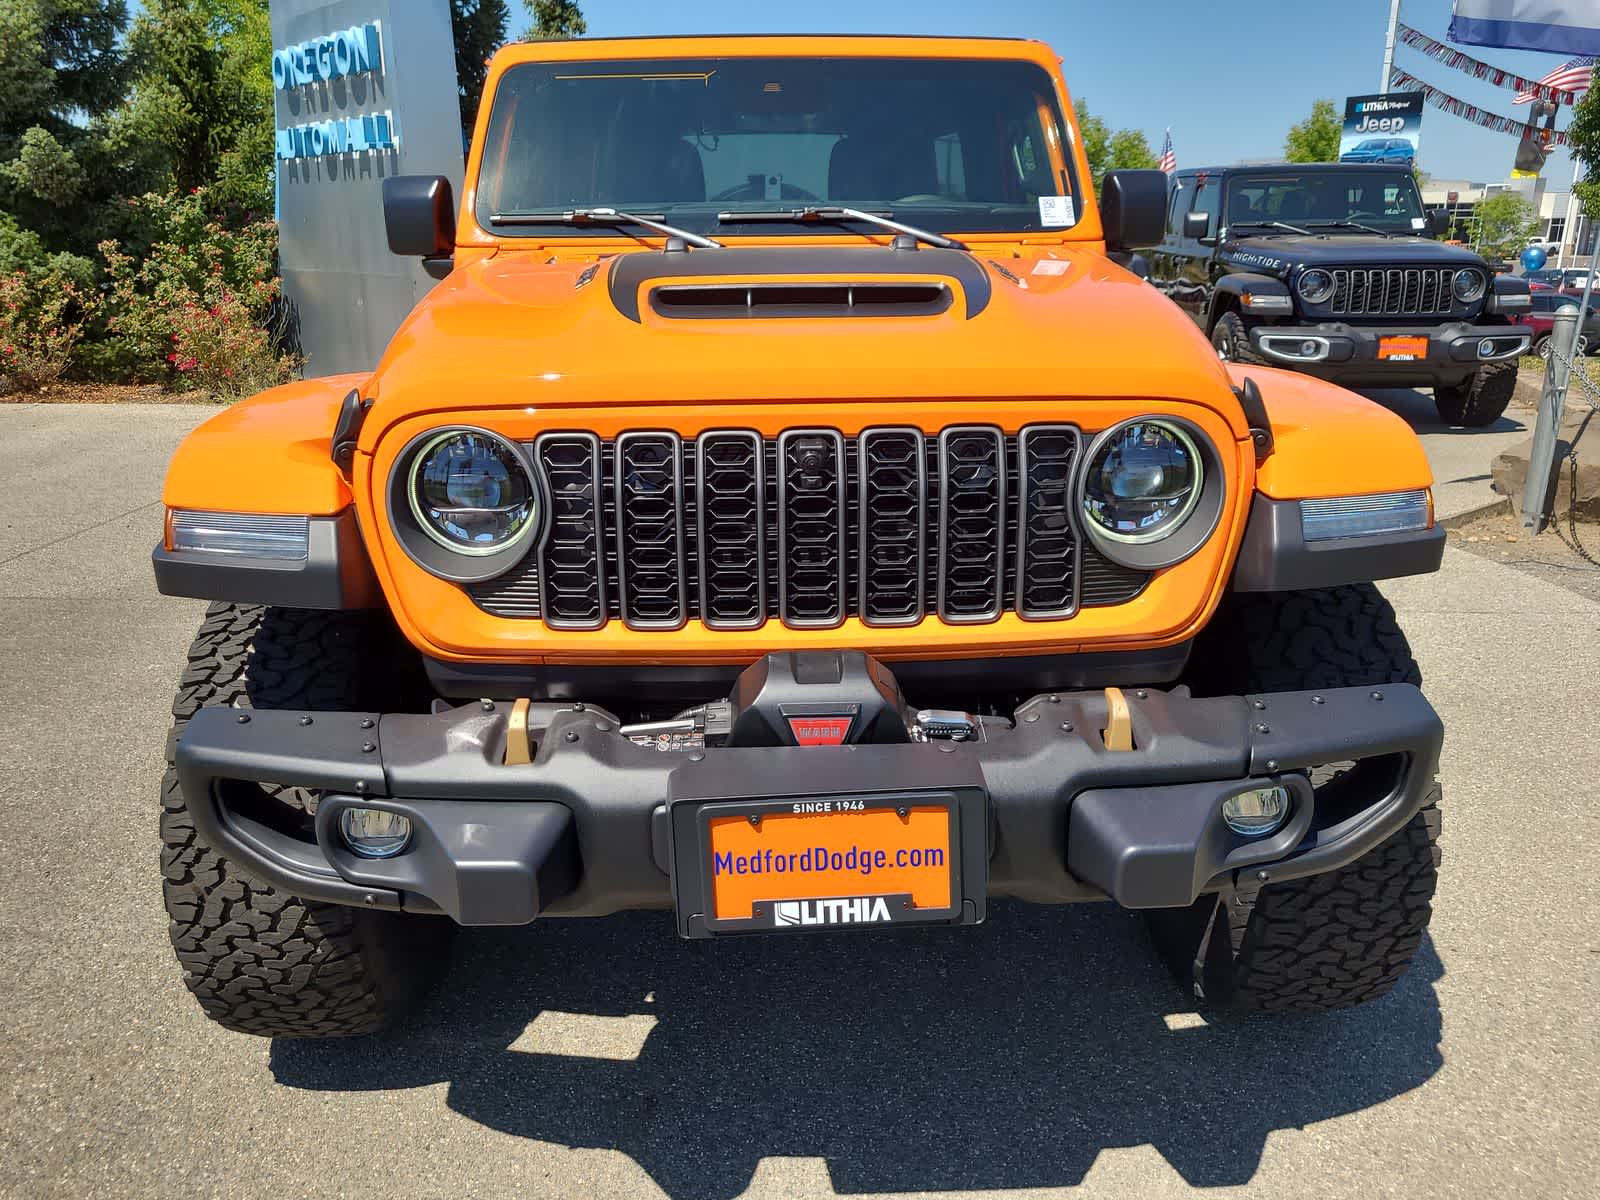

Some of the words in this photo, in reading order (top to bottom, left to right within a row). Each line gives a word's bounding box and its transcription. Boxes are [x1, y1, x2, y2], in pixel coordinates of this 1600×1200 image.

[272, 20, 384, 90] OREGON
[1362, 101, 1388, 111] LITHIA
[275, 111, 399, 161] AUTOMALL
[1355, 115, 1404, 134] Jeep
[792, 802, 832, 814] SINCE
[836, 800, 865, 812] 1946
[714, 845, 945, 876] MedfordDodge.com
[800, 897, 891, 926] LITHIA
